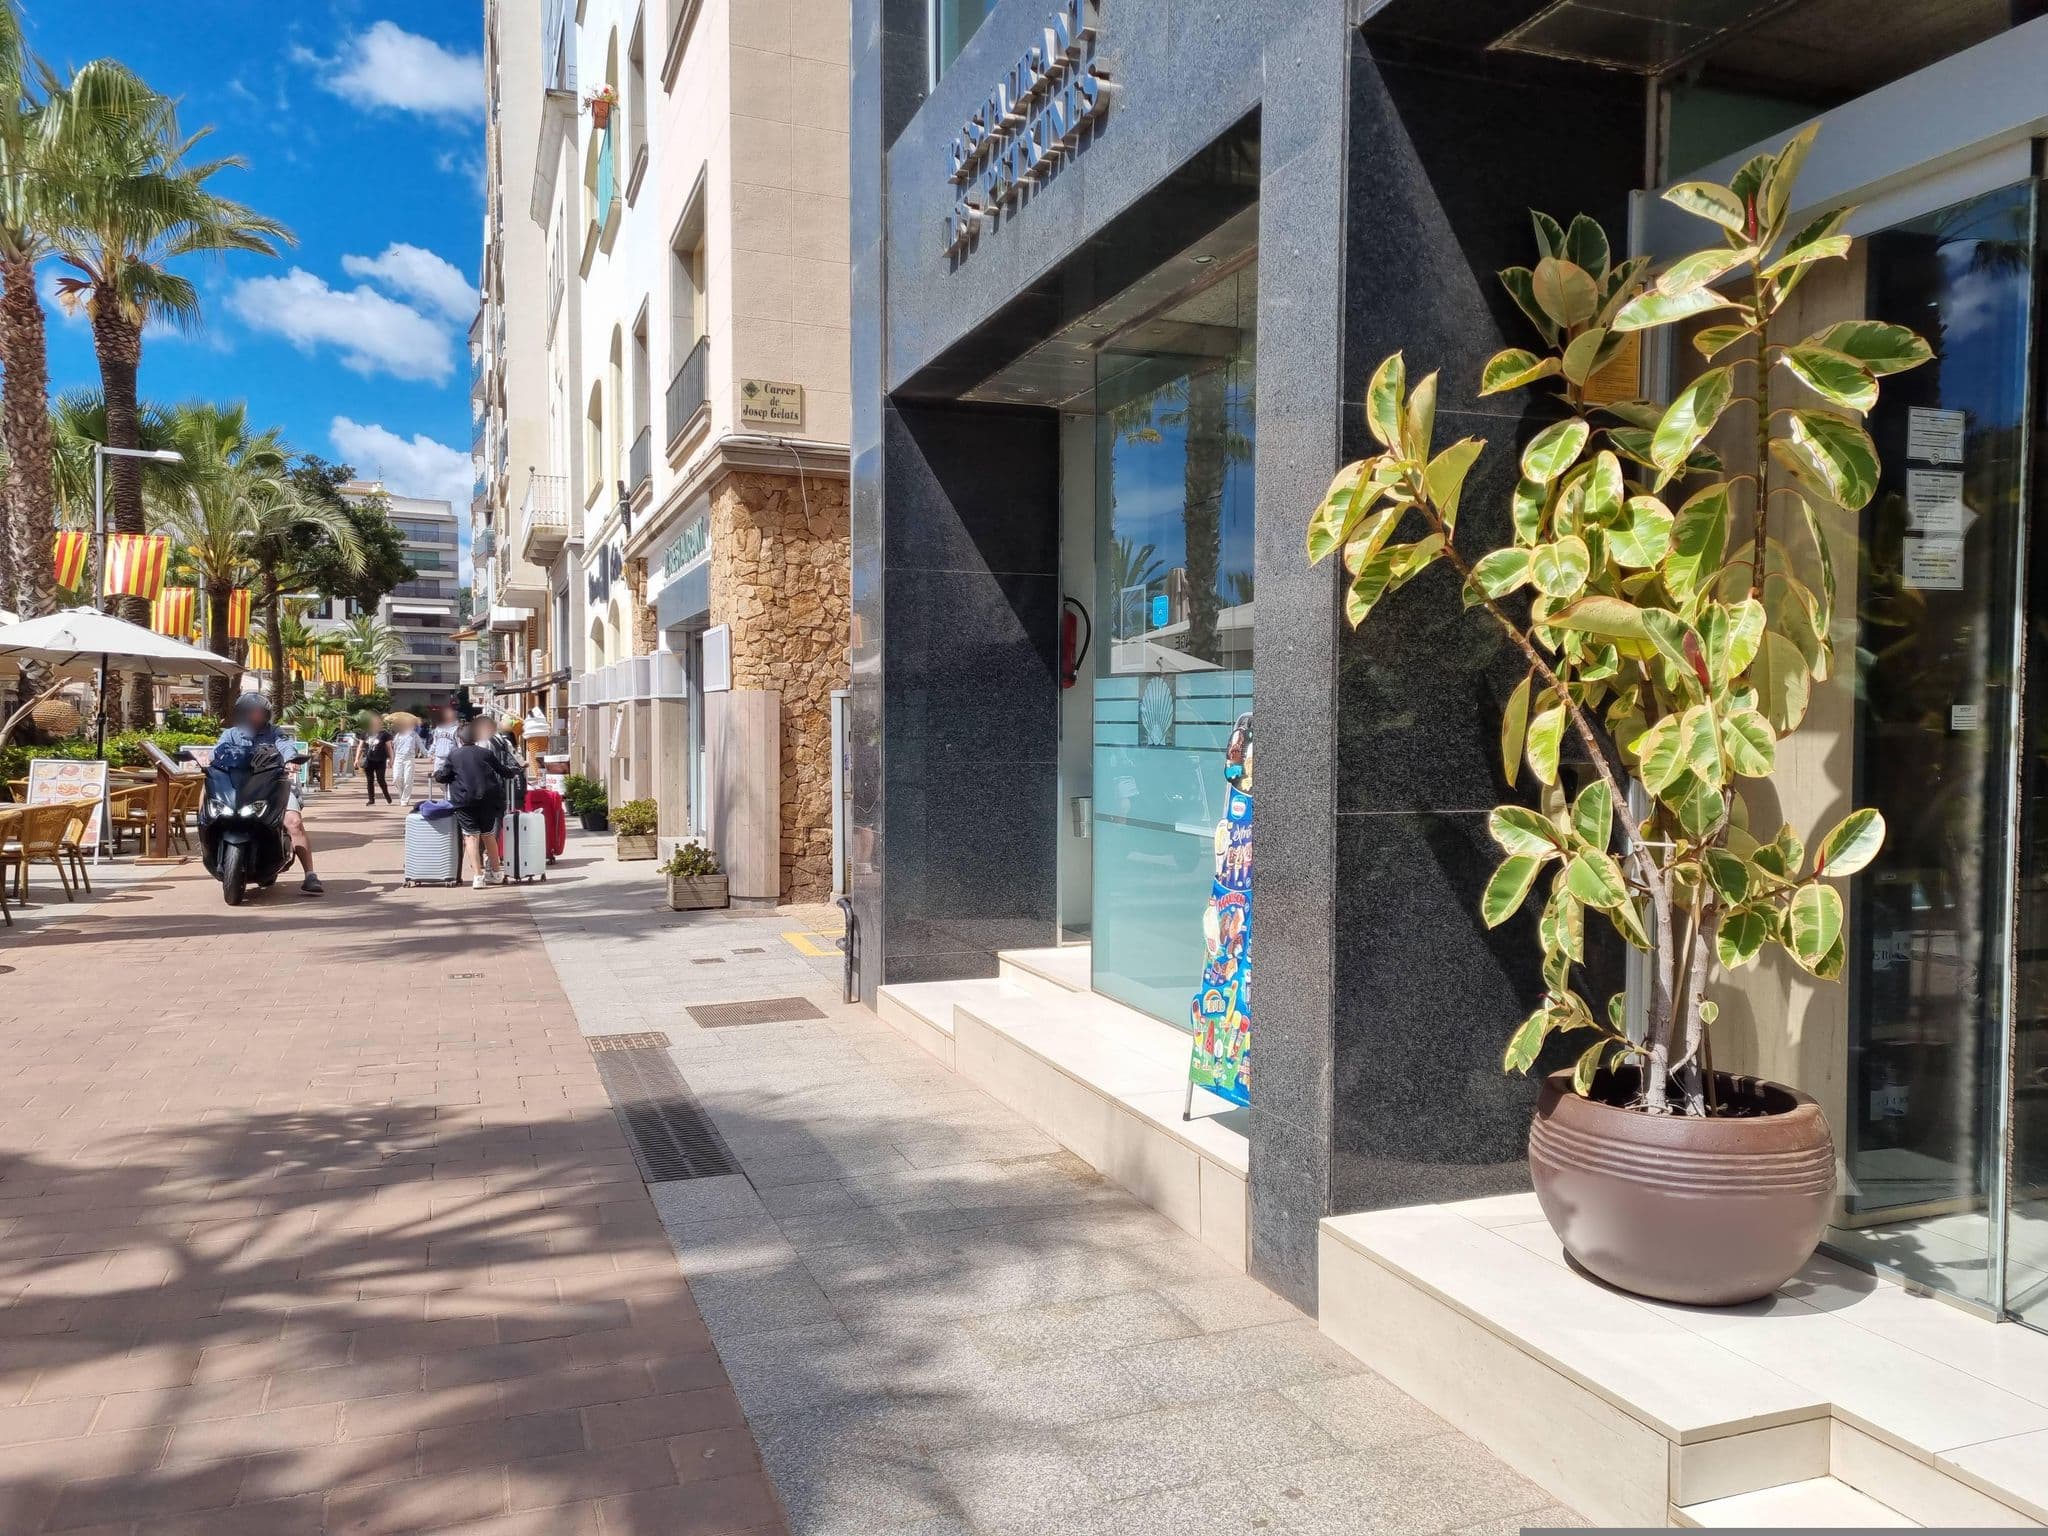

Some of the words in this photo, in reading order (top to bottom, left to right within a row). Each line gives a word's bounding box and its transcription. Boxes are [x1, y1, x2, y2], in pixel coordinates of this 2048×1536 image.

[764, 383, 796, 396] Carrer
[770, 396, 780, 407] de
[742, 405, 768, 420] Josep
[770, 407, 799, 420] Gelats
